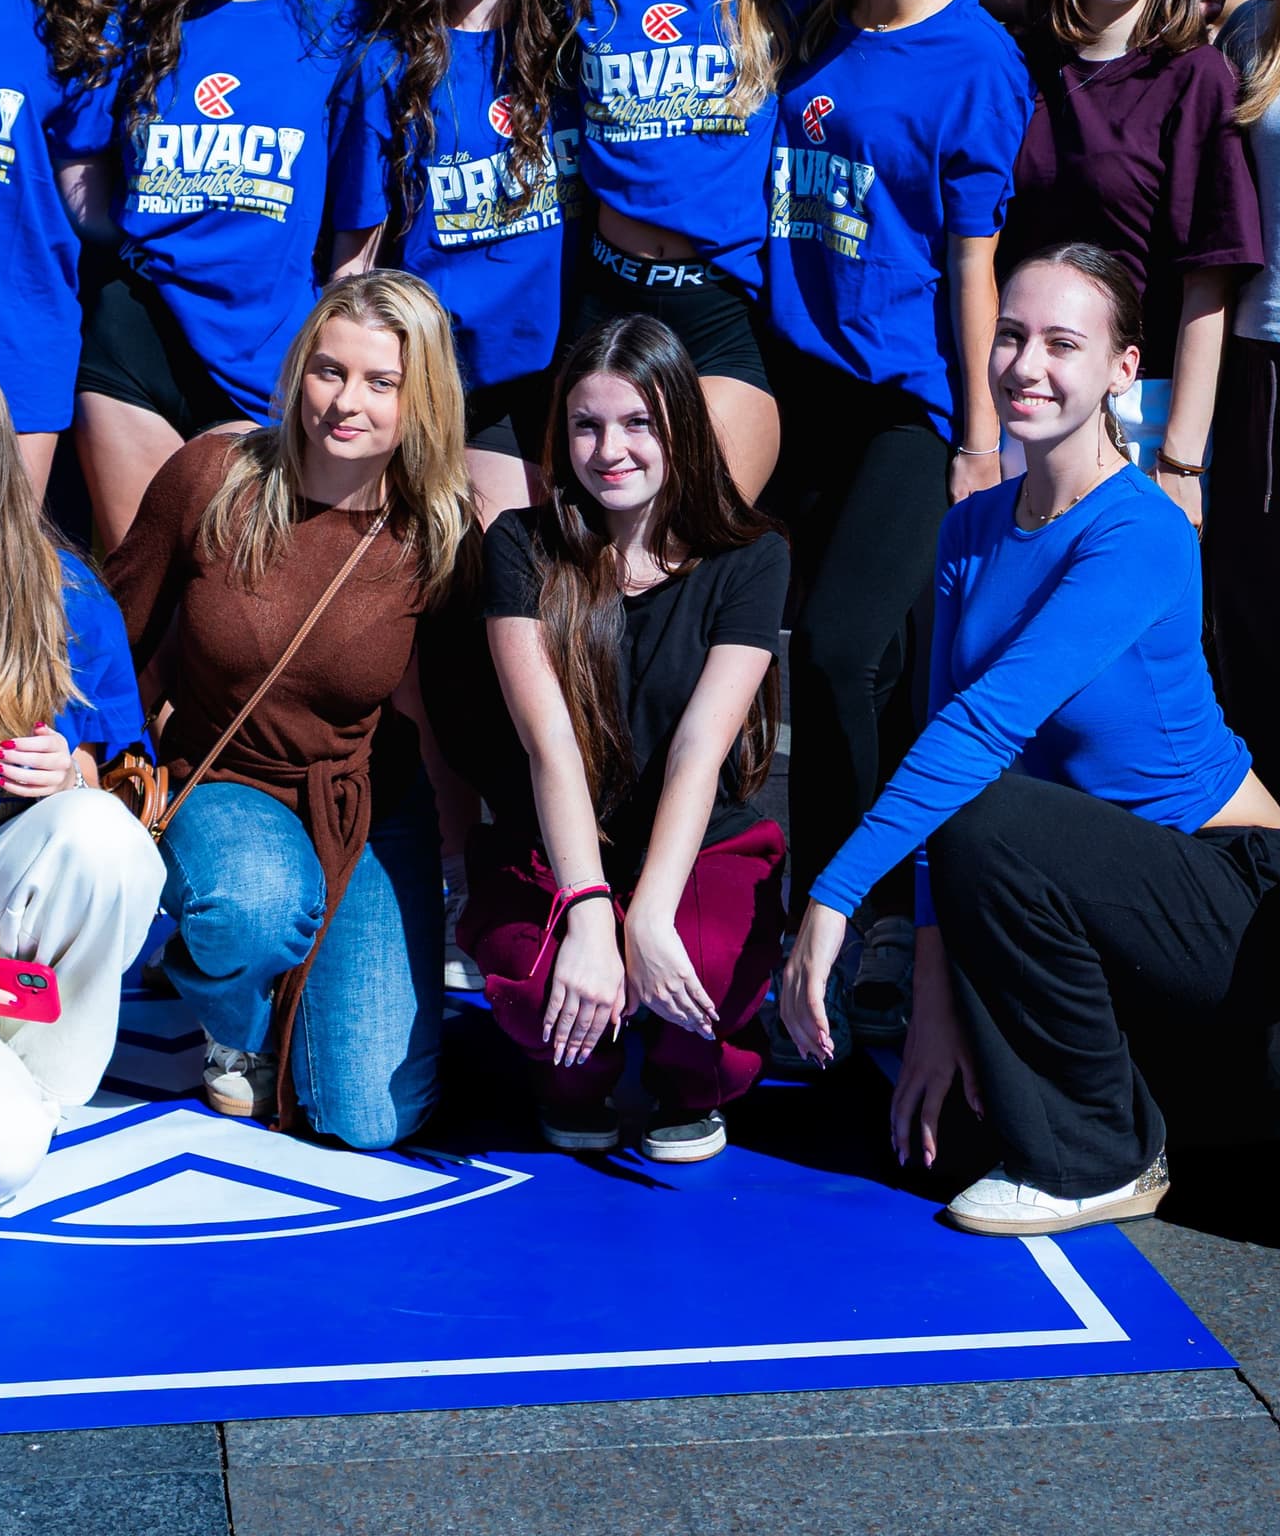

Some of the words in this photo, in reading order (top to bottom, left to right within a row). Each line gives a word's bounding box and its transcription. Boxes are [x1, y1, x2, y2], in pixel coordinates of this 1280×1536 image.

[603, 120, 662, 143] PROVED
[145, 164, 255, 200] Hrvatske
[137, 195, 204, 214] PROVED
[592, 233, 642, 282] NIKE
